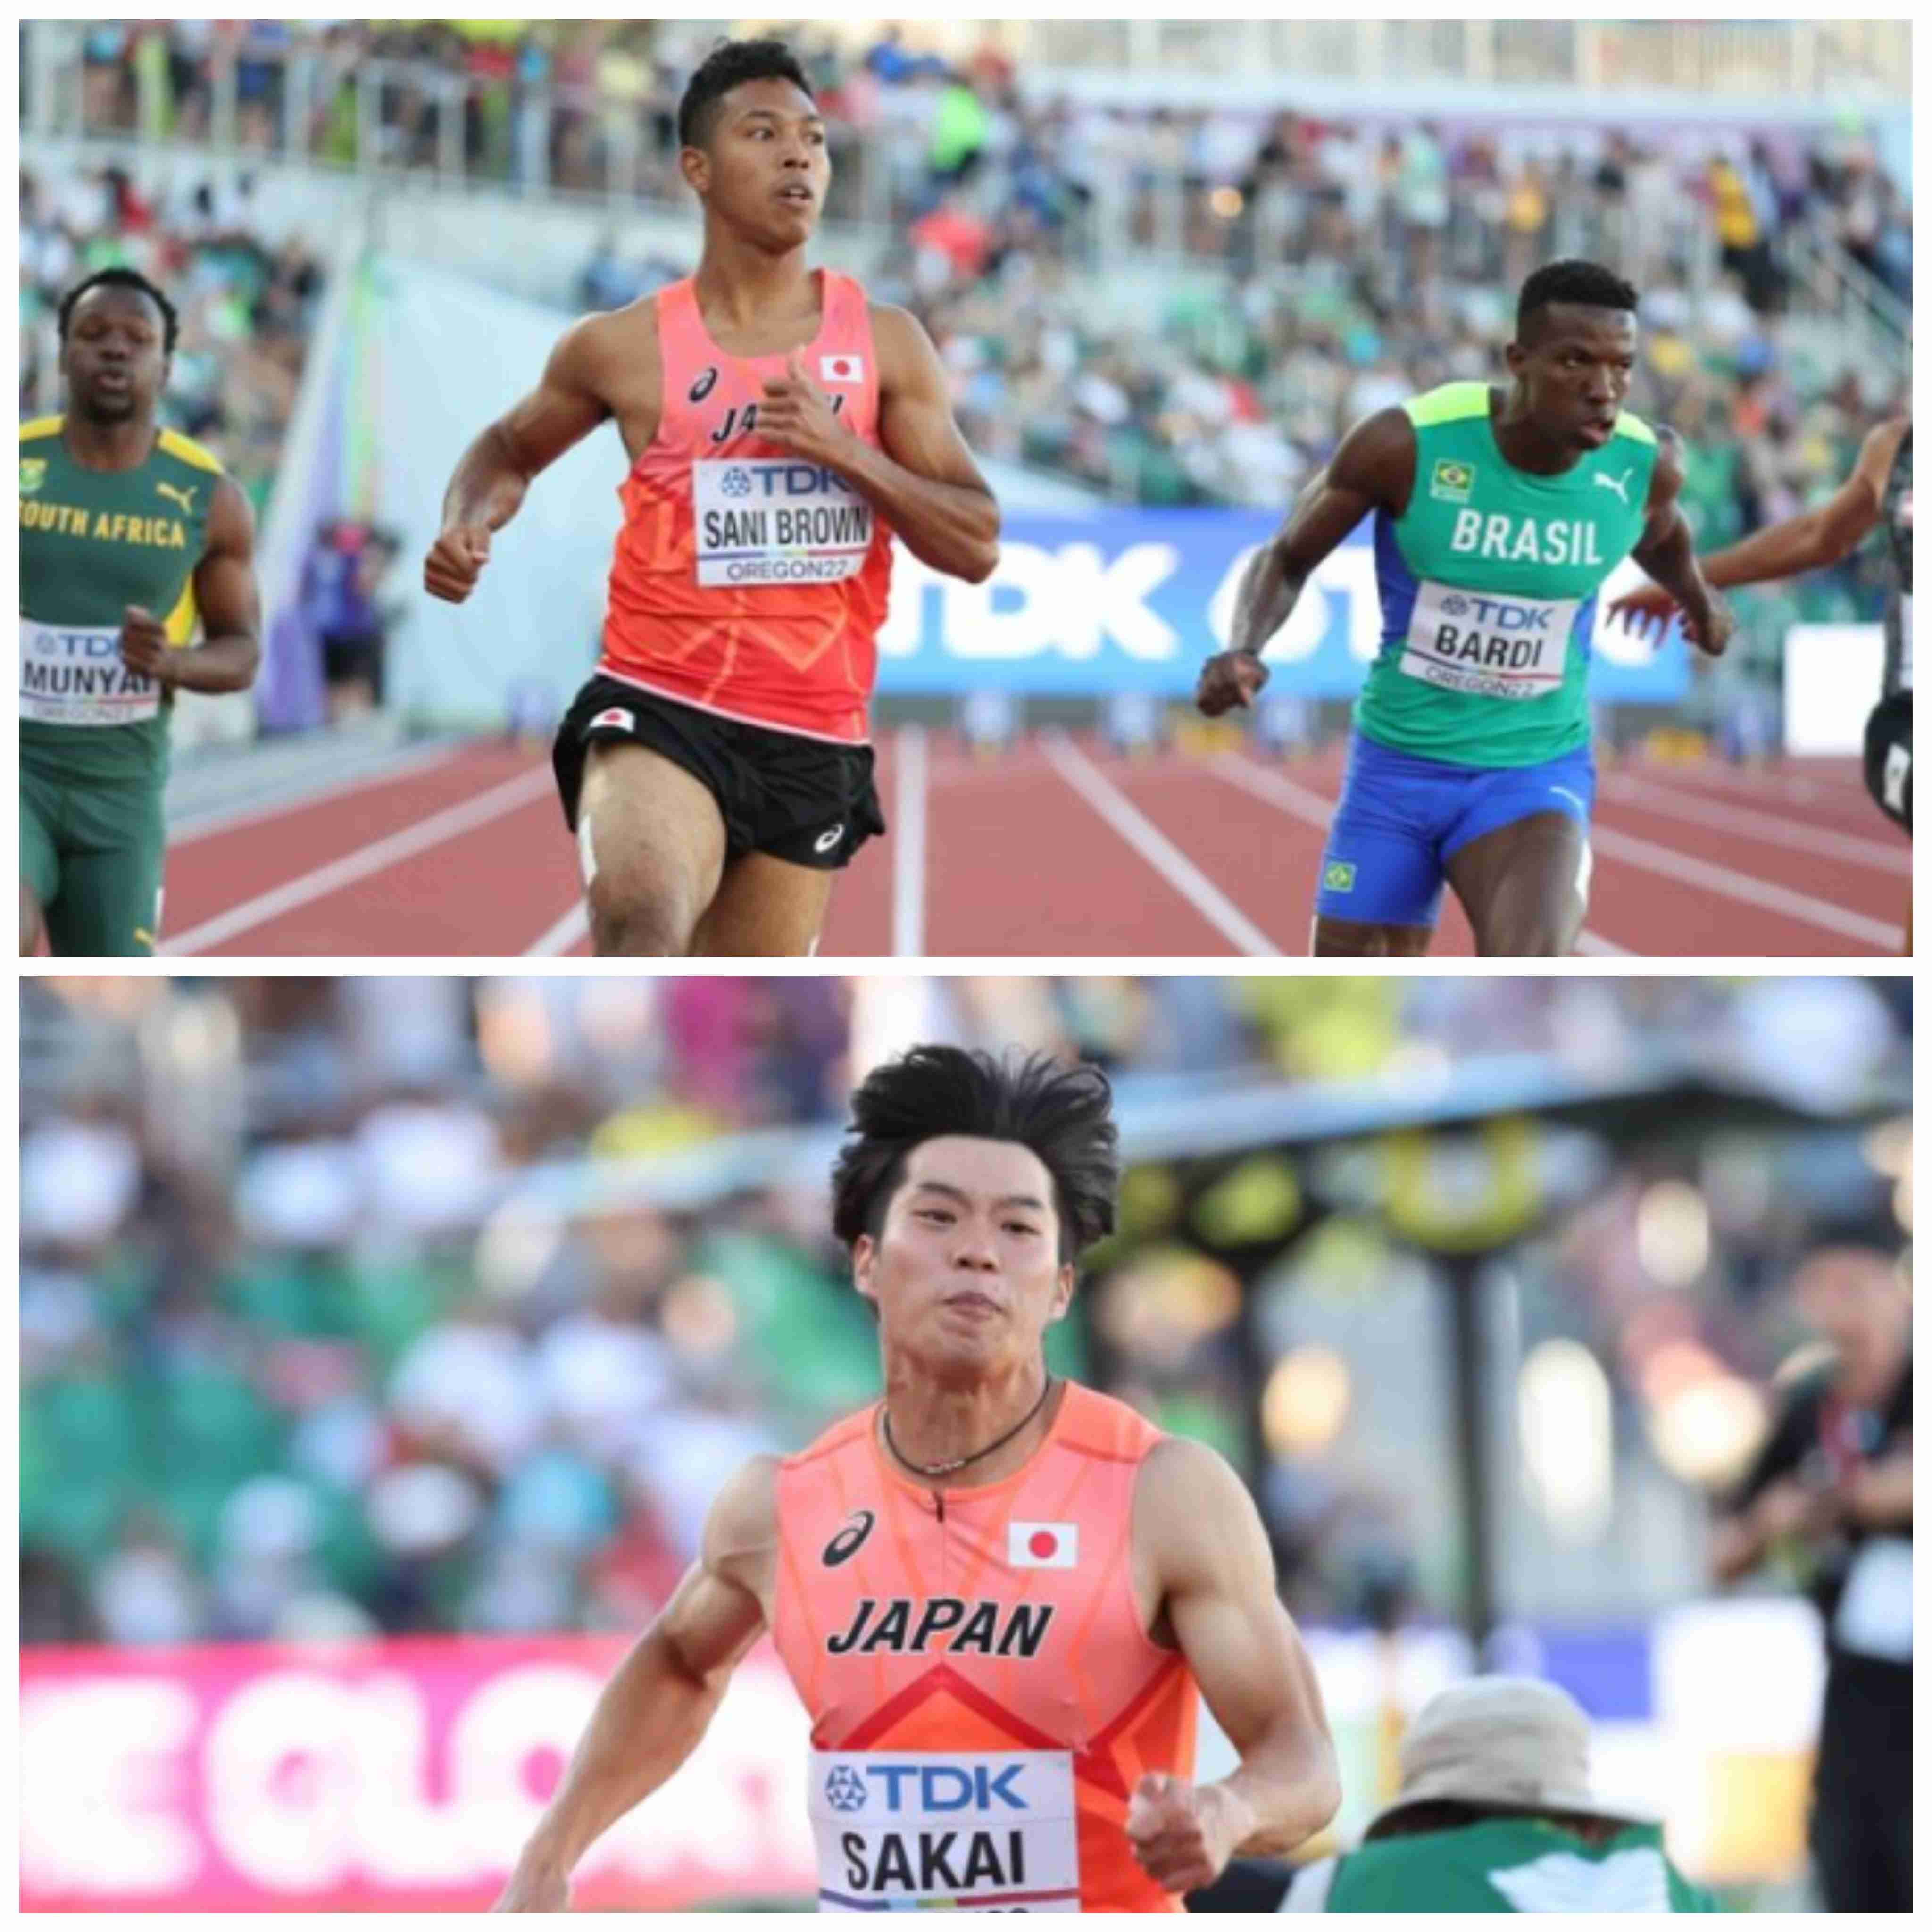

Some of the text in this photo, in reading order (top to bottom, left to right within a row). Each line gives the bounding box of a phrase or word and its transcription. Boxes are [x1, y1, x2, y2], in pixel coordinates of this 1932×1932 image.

[19, 499, 184, 548] OUTH AFRICA
[704, 505, 869, 549] SANI BROWN
[1451, 508, 1603, 566] BRASIL
[726, 558, 849, 581] OREGON22
[1470, 597, 1554, 631] TDK
[58, 633, 124, 657] TD
[1434, 624, 1544, 668] BARDI
[1424, 666, 1534, 698] OREGON22
[826, 1598, 1054, 1658] JAPAN
[866, 1764, 1029, 1812] TDK
[841, 1831, 1025, 1891] SAKAI
